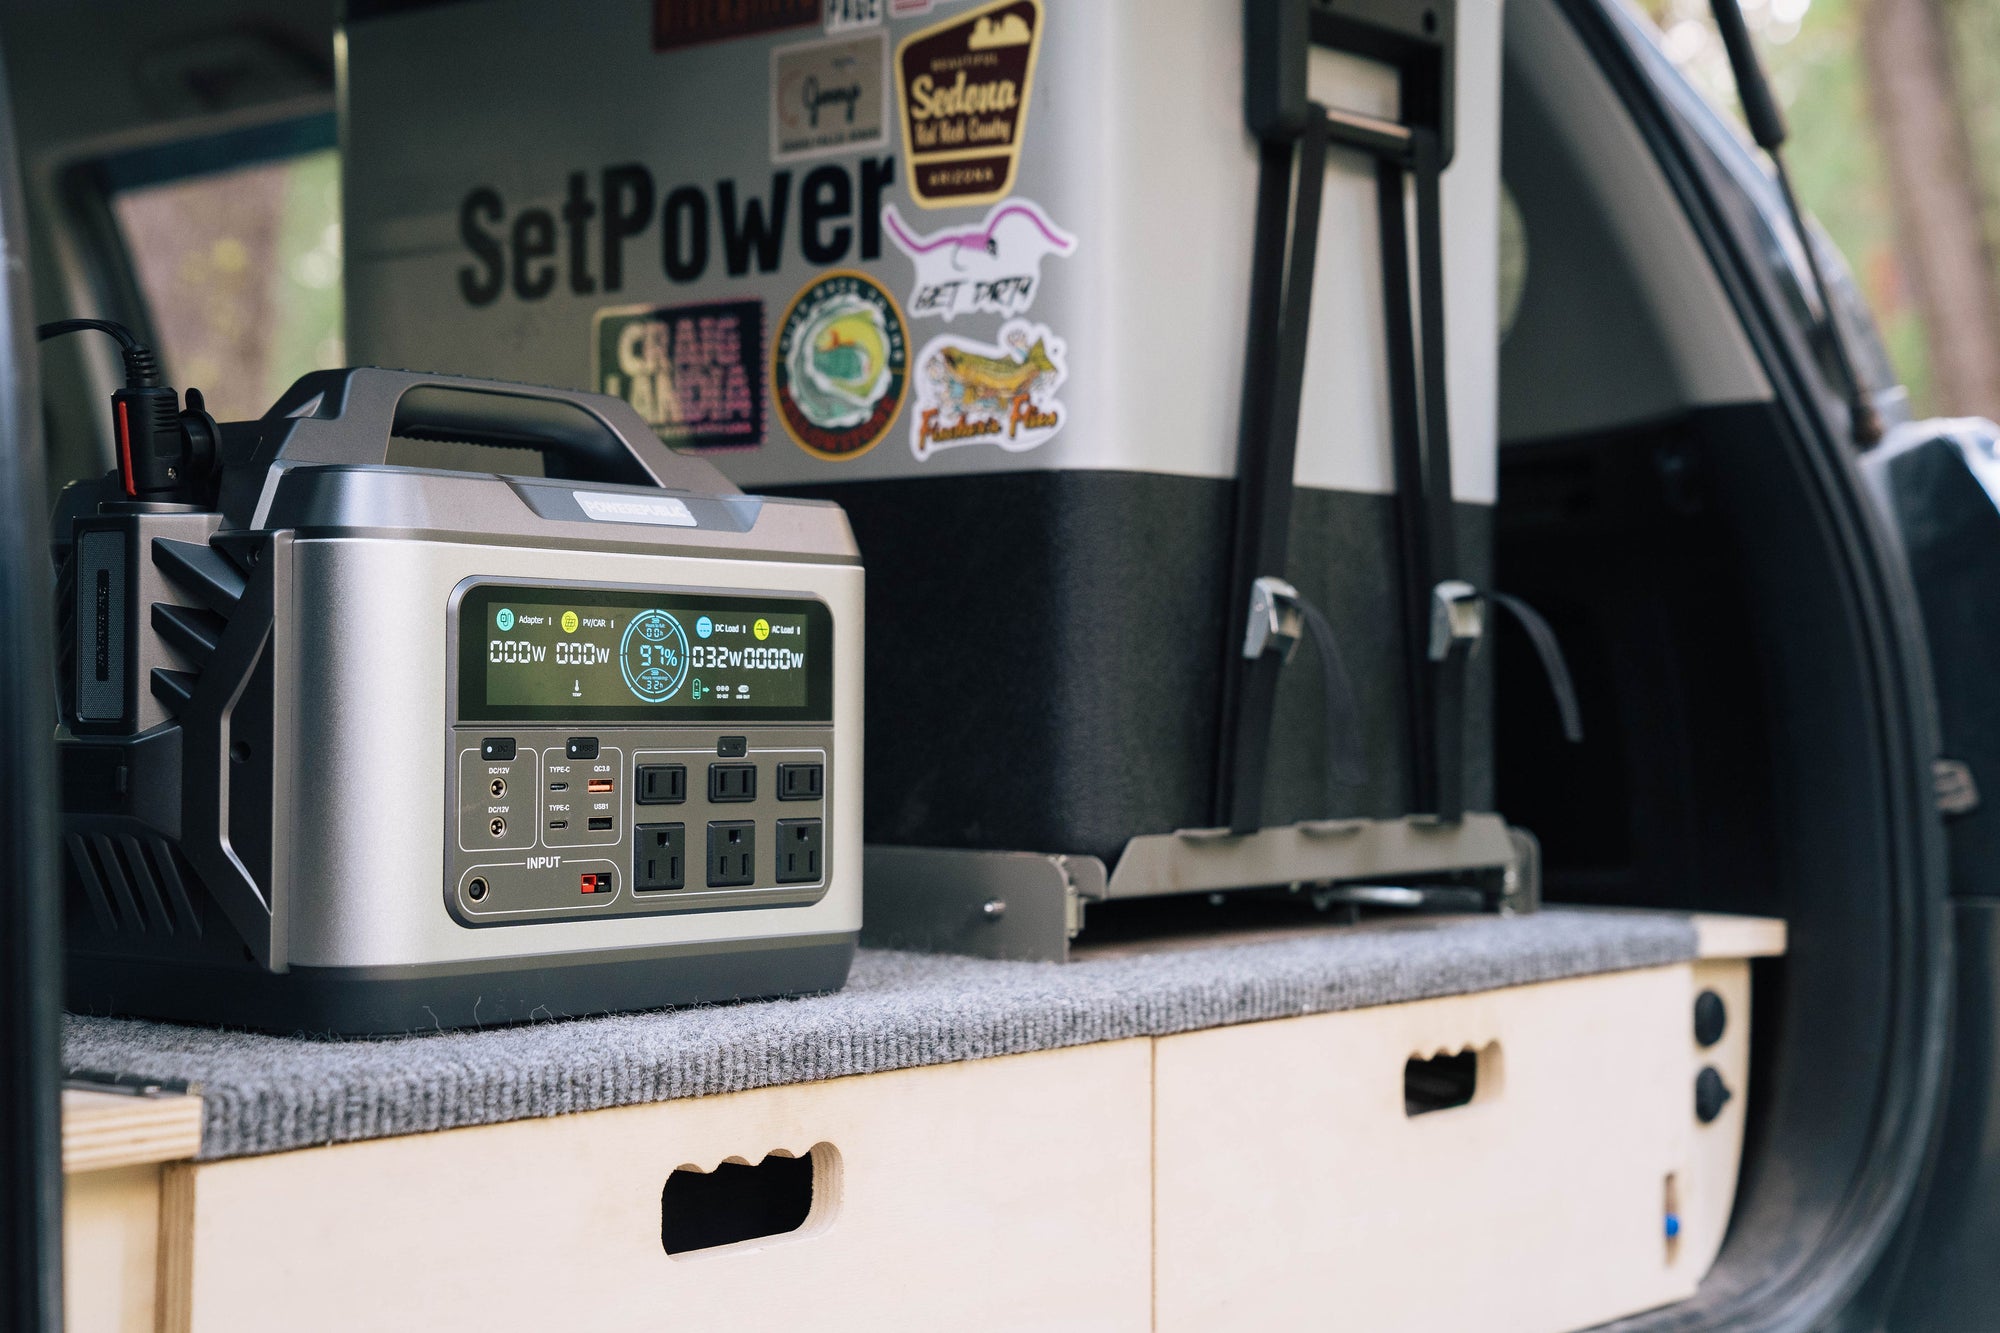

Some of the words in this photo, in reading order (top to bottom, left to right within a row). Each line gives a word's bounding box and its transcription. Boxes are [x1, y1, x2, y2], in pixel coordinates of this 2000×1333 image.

[911, 71, 1018, 119] Sedona
[968, 117, 1012, 143] Country
[928, 166, 994, 186] ARIZONA
[458, 155, 895, 308] SetPower
[914, 279, 966, 311] GET
[974, 276, 1034, 308] DIRTY
[518, 615, 544, 625] Adapter
[582, 618, 606, 628] PV/CAR
[715, 624, 725, 632] DC
[725, 624, 740, 633] Load
[771, 626, 780, 634] AC
[780, 626, 794, 634] Load
[490, 640, 547, 663] 000W
[556, 642, 610, 665] 000W
[640, 644, 678, 667] 97%
[692, 646, 743, 668] 032W
[743, 647, 804, 670] 0000W
[526, 856, 561, 869] INPUT
